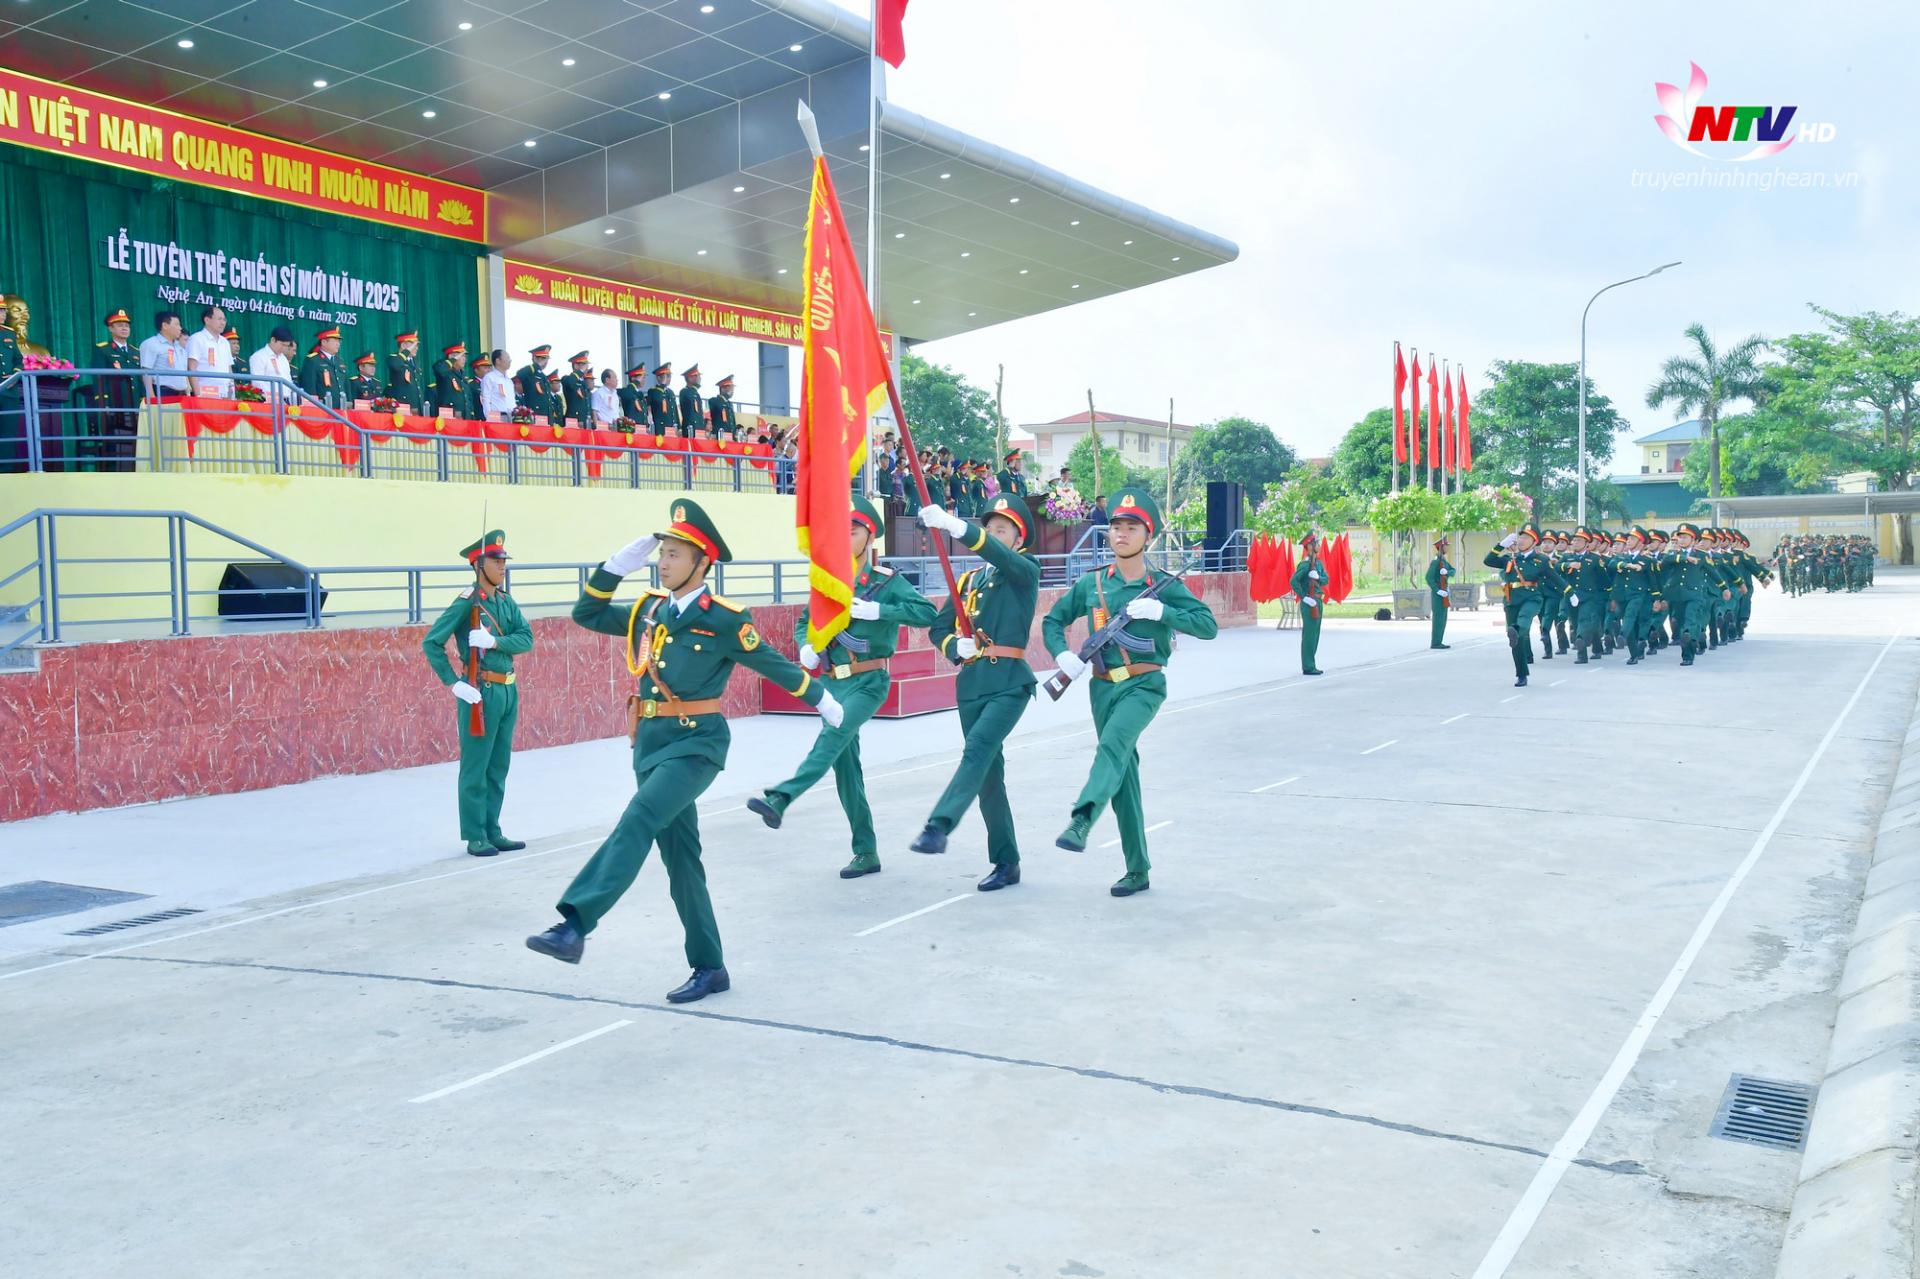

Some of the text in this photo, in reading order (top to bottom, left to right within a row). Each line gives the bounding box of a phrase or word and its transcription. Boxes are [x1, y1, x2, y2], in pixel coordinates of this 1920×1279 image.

[29, 96, 89, 147] VIỆT
[99, 112, 163, 161] NAM
[172, 131, 253, 181] QUANG
[261, 152, 312, 194] VINH
[319, 168, 378, 208] MUÔN
[384, 180, 429, 220] NĂM
[108, 227, 400, 313] LỄ TUYÊN THỆ CHIẾN SĨ MỚI NĂM 2025
[157, 285, 190, 304] Nghệ
[221, 296, 248, 312] ngày
[249, 298, 263, 312] 04
[263, 302, 294, 320] tháng
[298, 305, 305, 318] 6
[308, 309, 332, 322] năm
[335, 311, 357, 325] 2025
[550, 277, 580, 303] HUẤN
[582, 286, 614, 311] LUYỆN
[667, 298, 684, 321] KẾT
[686, 301, 704, 327] TỐT,
[719, 310, 740, 333] LUẬT
